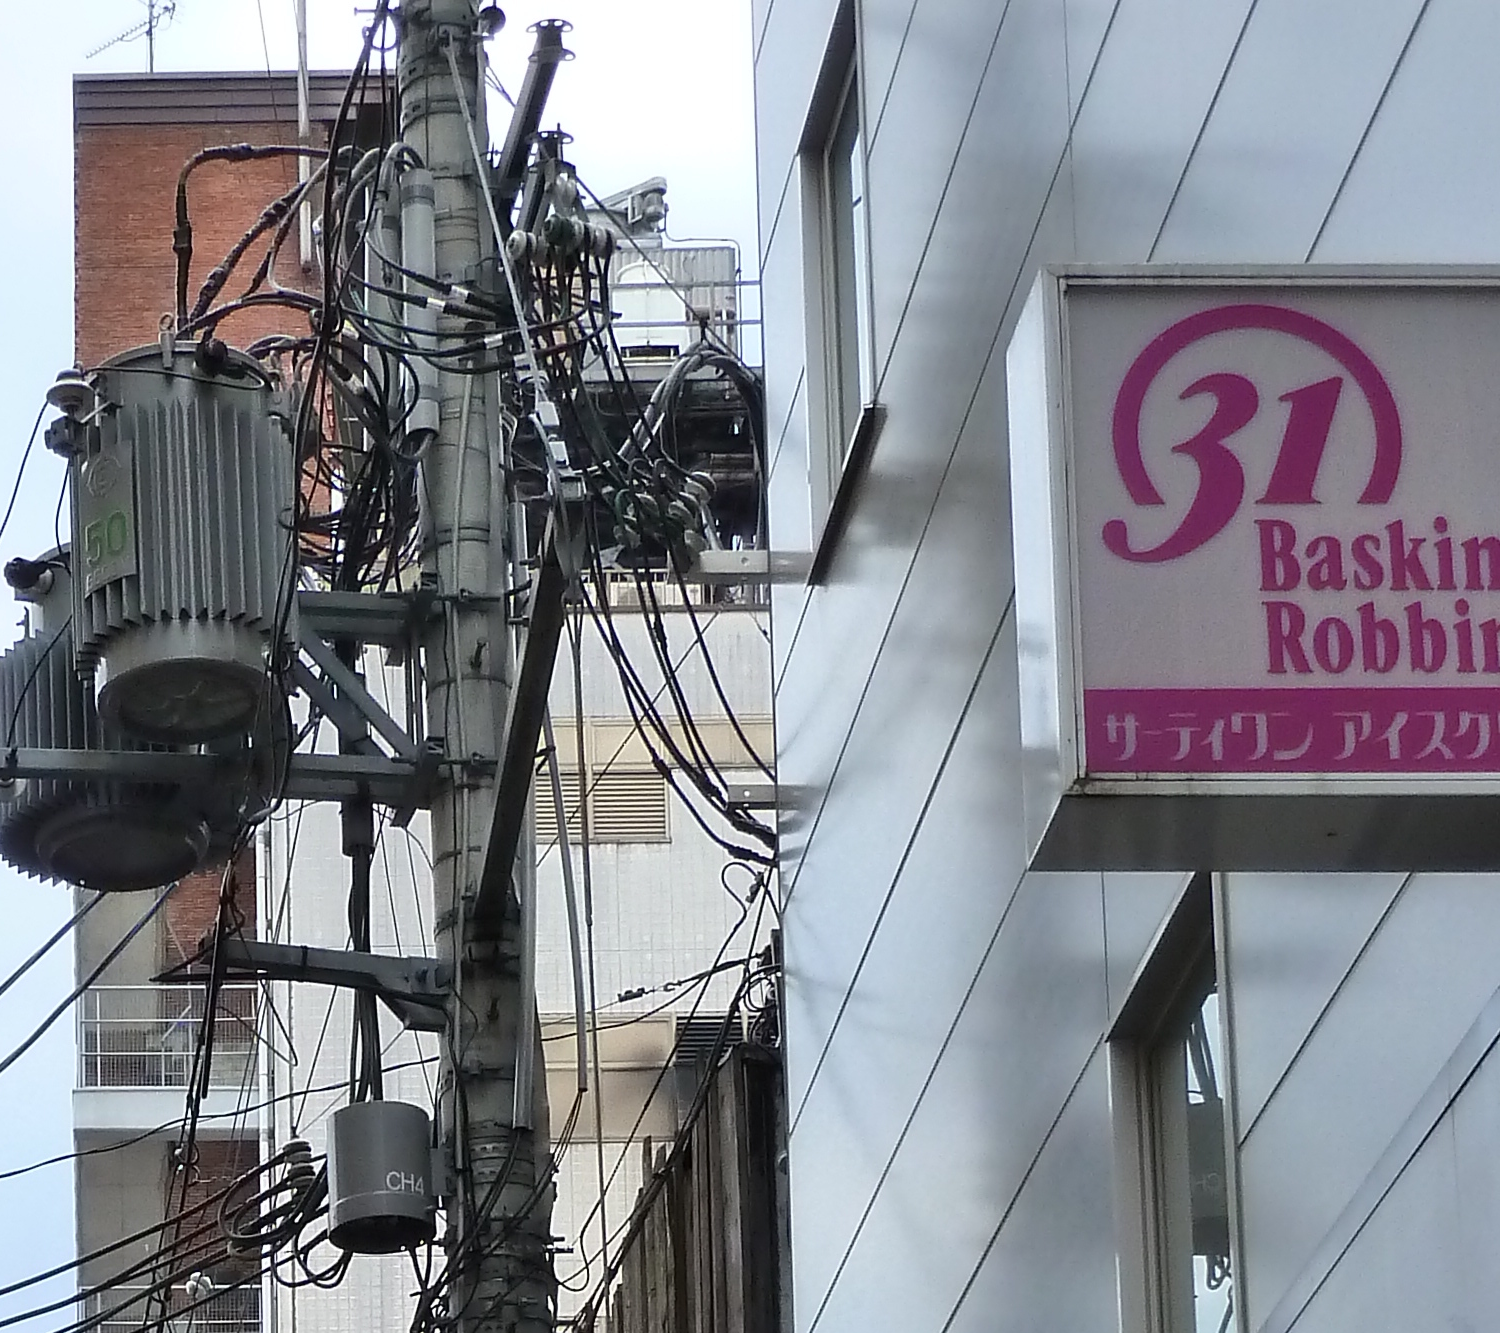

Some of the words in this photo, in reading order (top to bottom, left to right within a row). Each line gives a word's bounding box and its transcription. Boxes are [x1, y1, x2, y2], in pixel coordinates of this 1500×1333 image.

[1101, 372, 1344, 563] 31
[1103, 710, 1315, 762] サーティワン
[1333, 710, 1500, 762] アイスク
[386, 1171, 425, 1195] CH4
